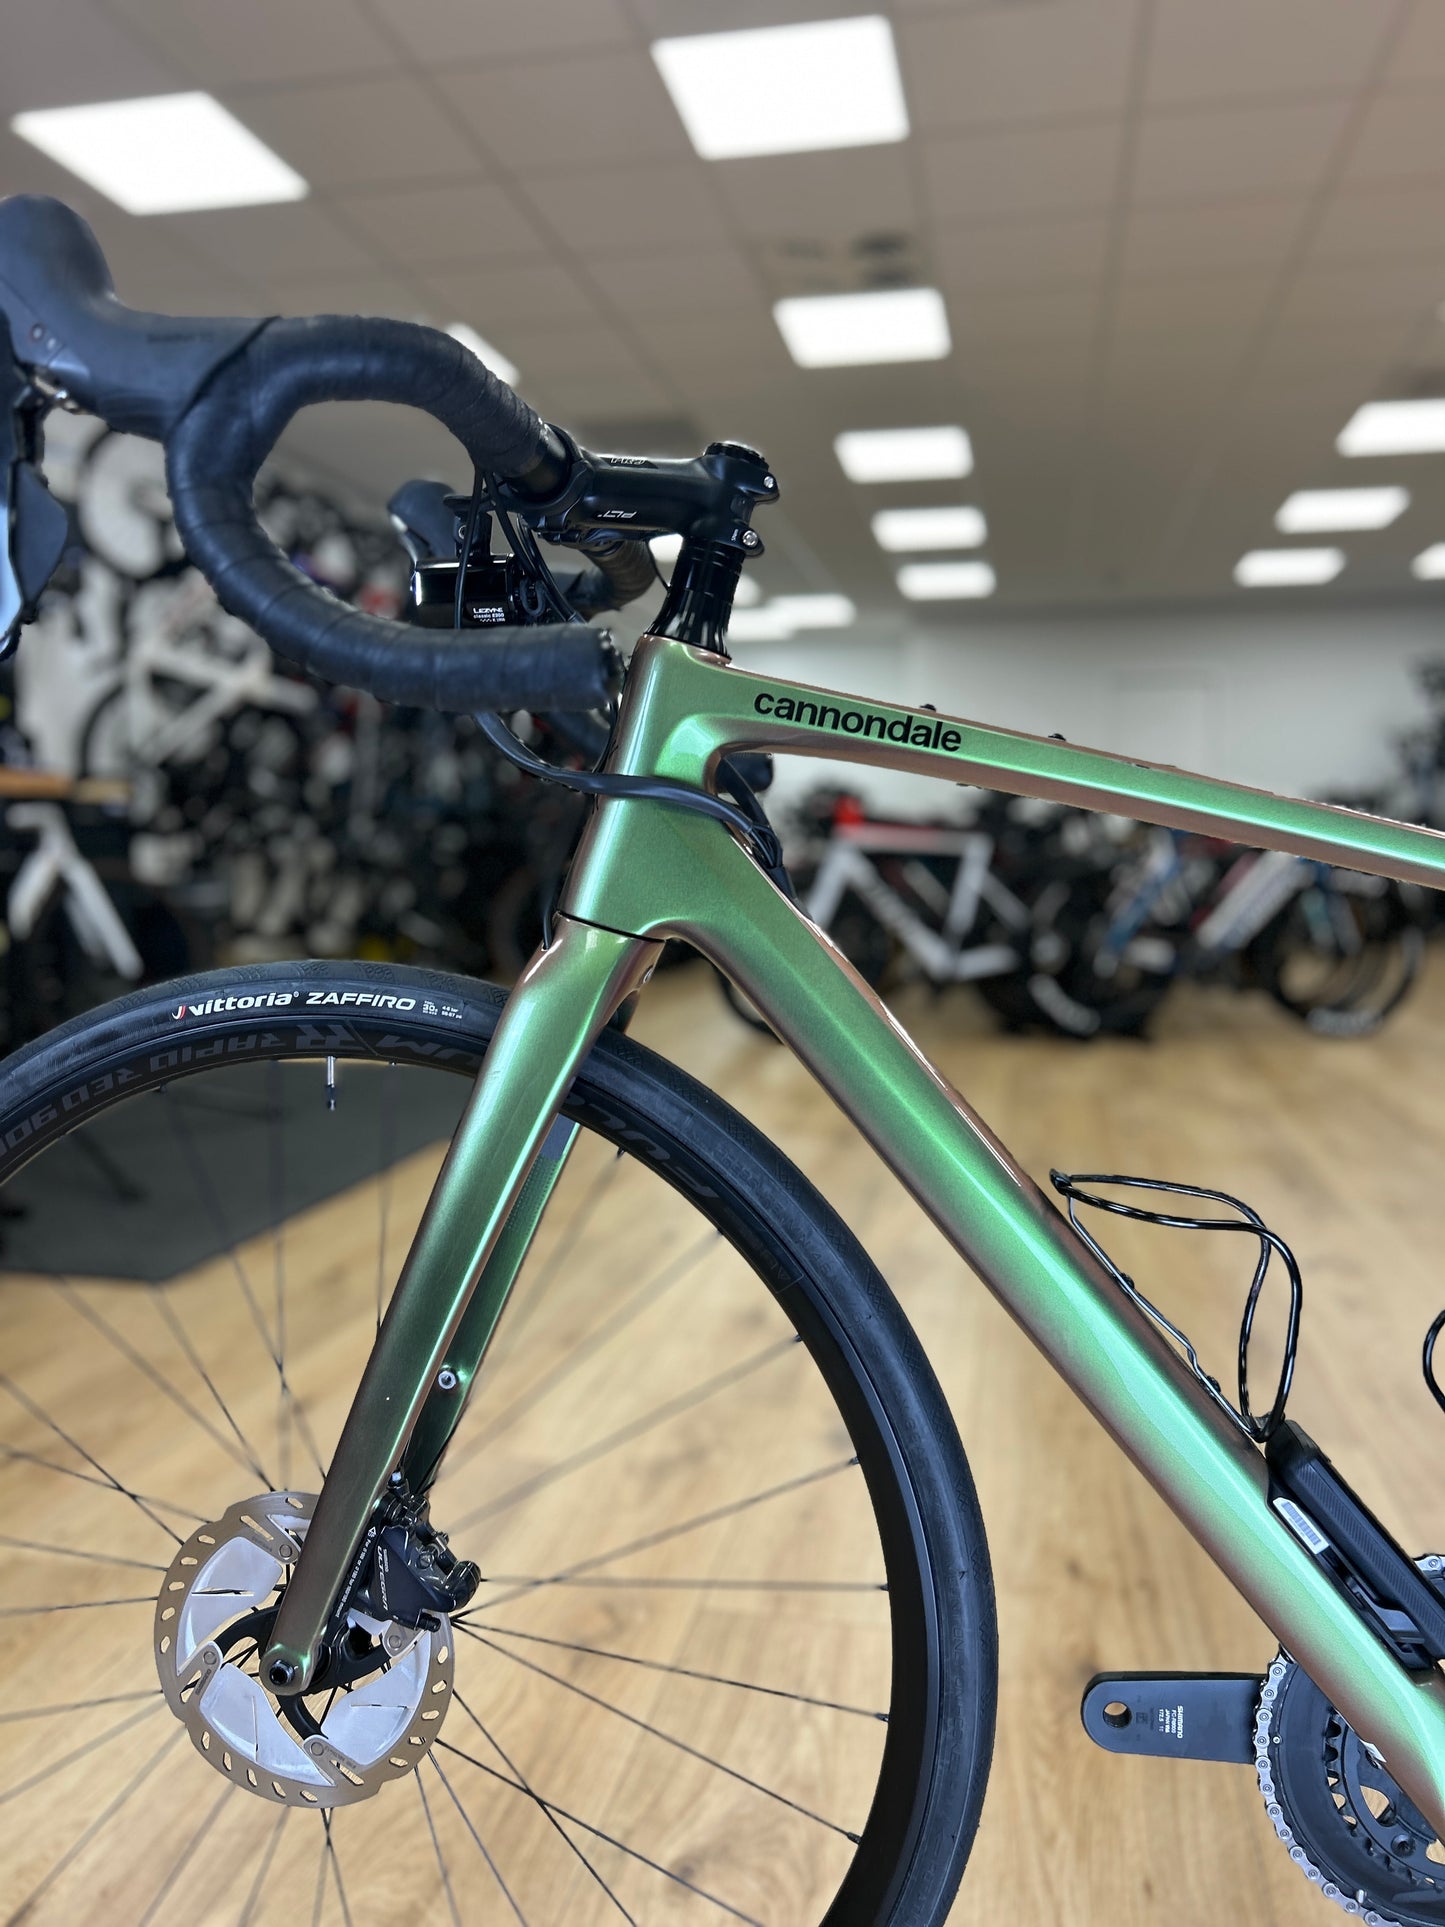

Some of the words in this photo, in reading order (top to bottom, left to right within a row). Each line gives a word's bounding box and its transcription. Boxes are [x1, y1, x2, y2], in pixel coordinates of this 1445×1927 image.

[754, 692, 962, 752] cannondale
[189, 990, 293, 1018] vittoria
[305, 991, 417, 1012] ZAFFIRO
[151, 1032, 287, 1070] RAPID
[62, 1069, 144, 1110] RED
[0, 1104, 58, 1156] 90
[377, 1545, 389, 1611] ULTEGRA
